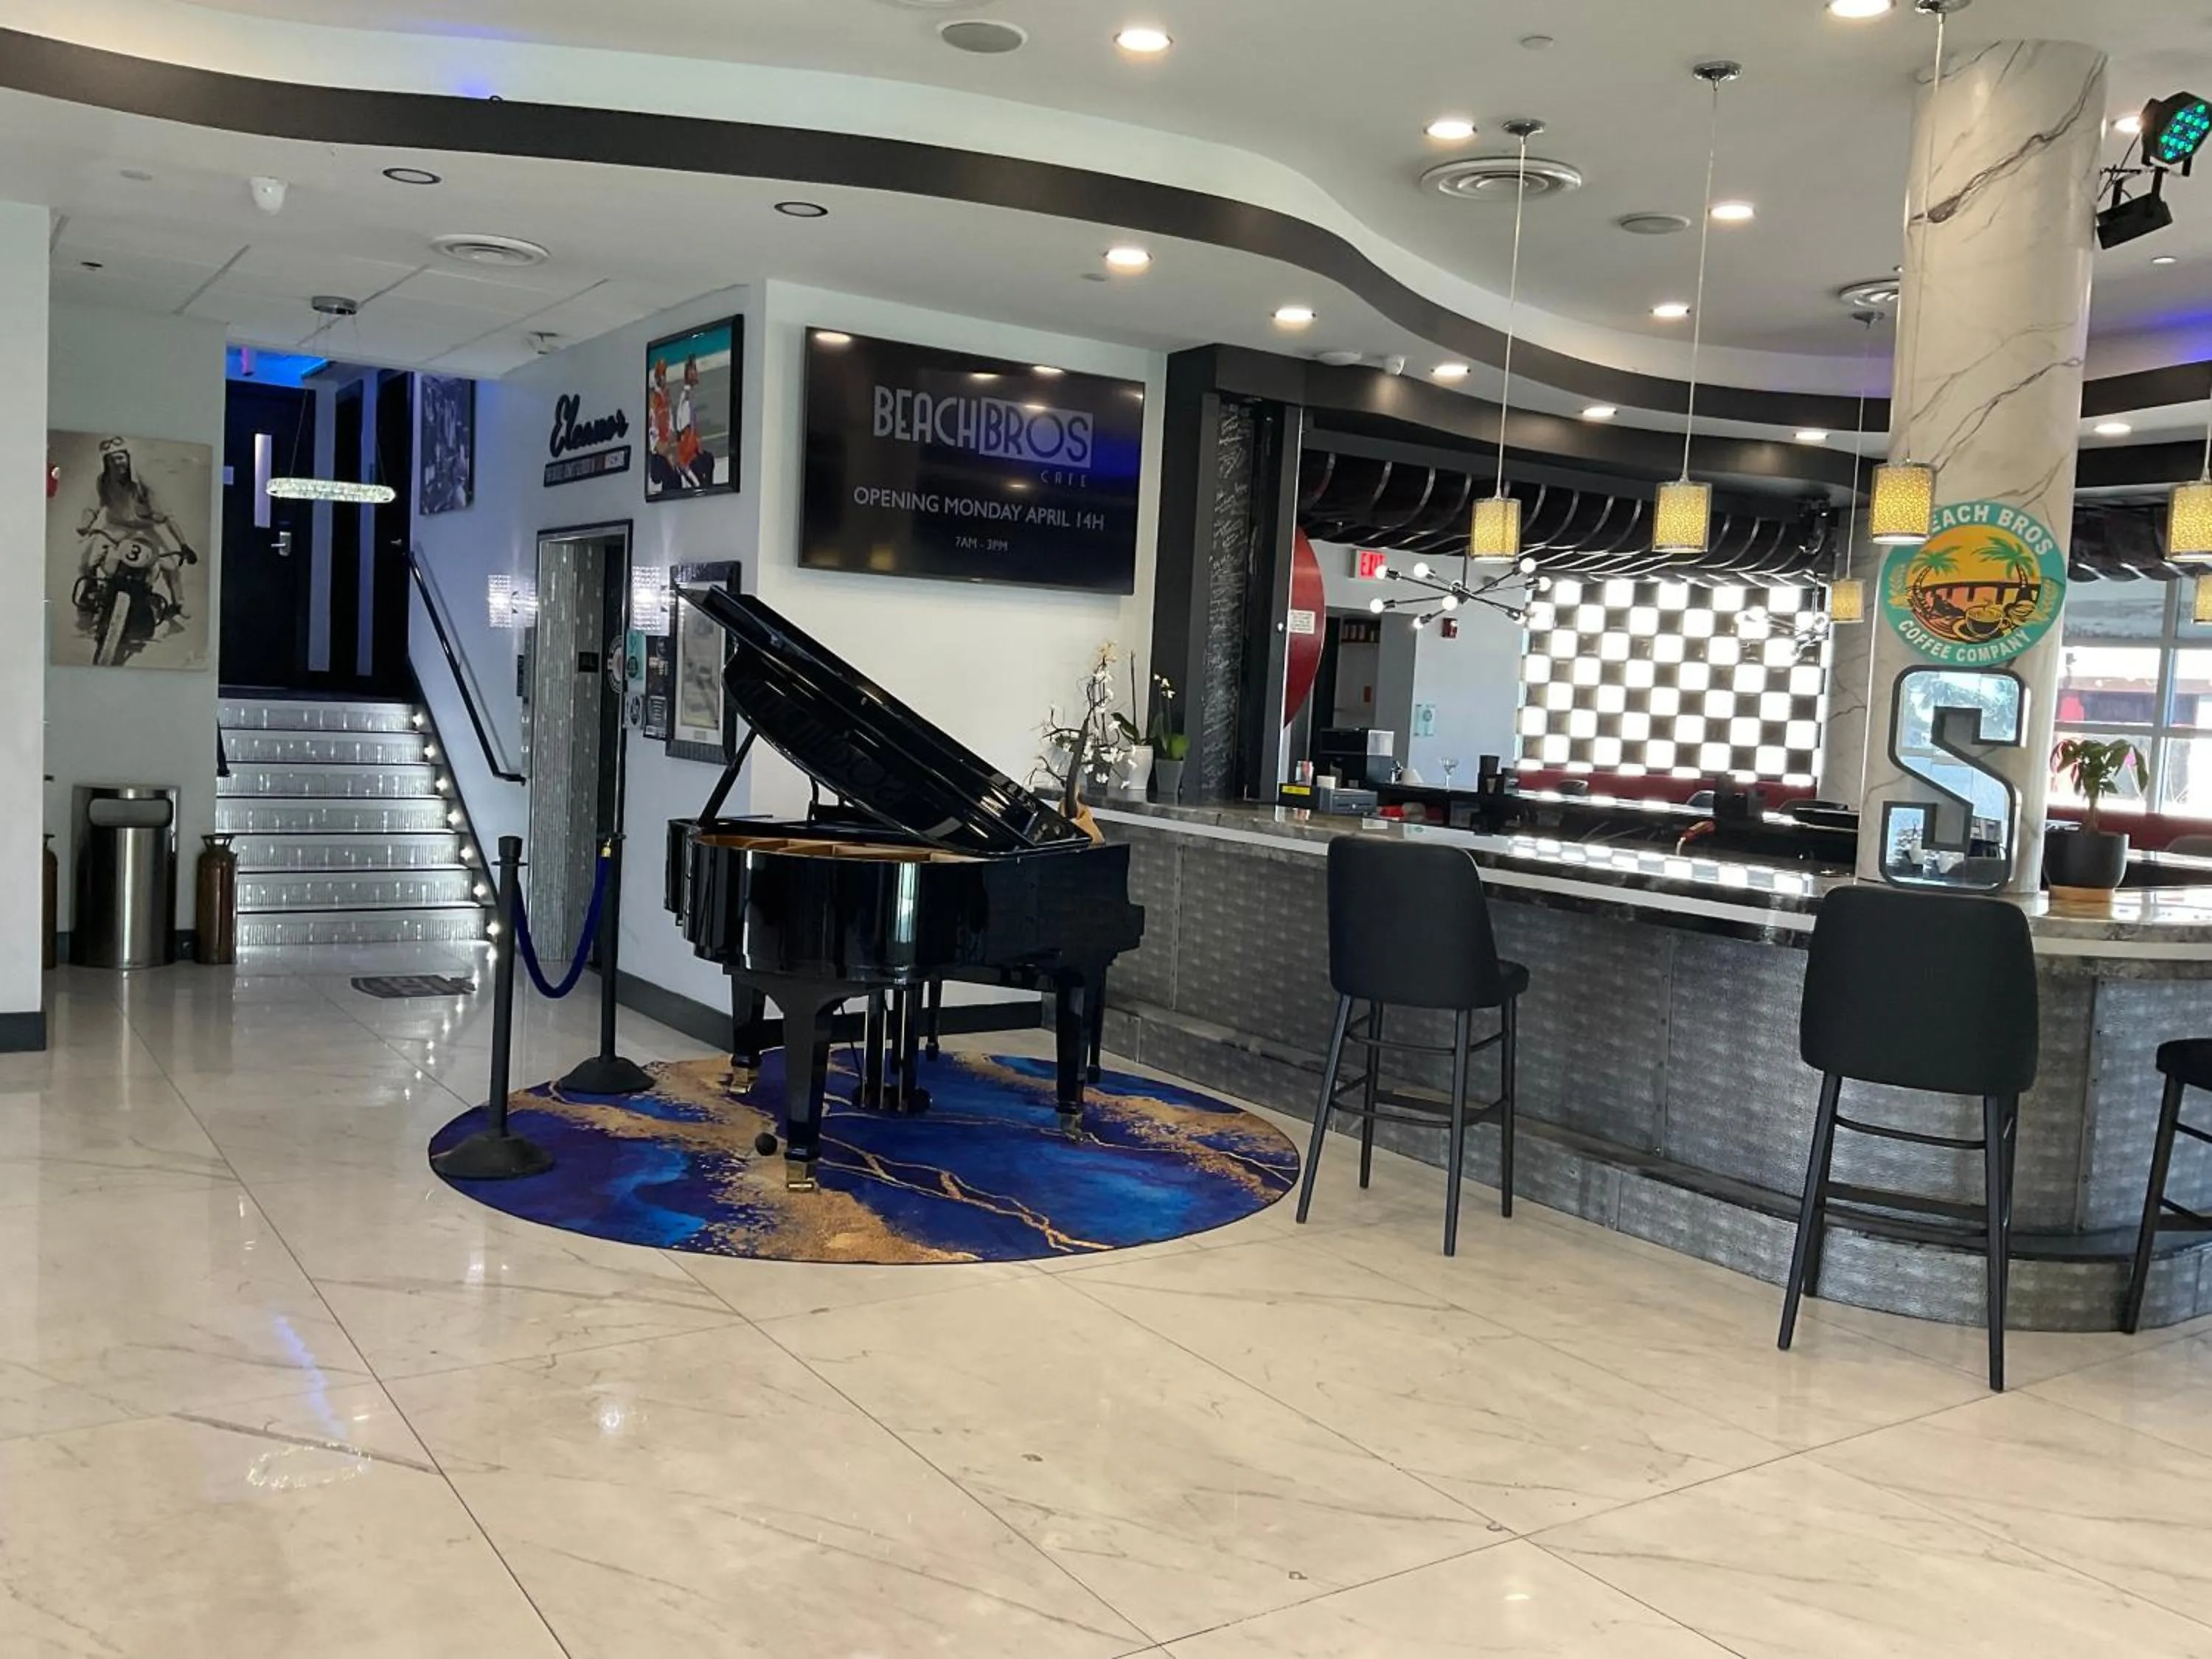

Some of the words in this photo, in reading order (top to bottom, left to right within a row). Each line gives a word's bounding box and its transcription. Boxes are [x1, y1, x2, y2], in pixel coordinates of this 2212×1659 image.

[854, 486, 939, 513] OPENING
[945, 496, 1023, 521] MONDAY
[1026, 506, 1071, 527] APRIL
[1077, 510, 1105, 531] 14H
[1931, 504, 1990, 533] EACH
[1997, 507, 2054, 556] BROS
[125, 544, 142, 561] 3
[956, 536, 978, 549] 7AM
[1899, 620, 1952, 659] COFFEE
[1956, 630, 2032, 663] COMPANY
